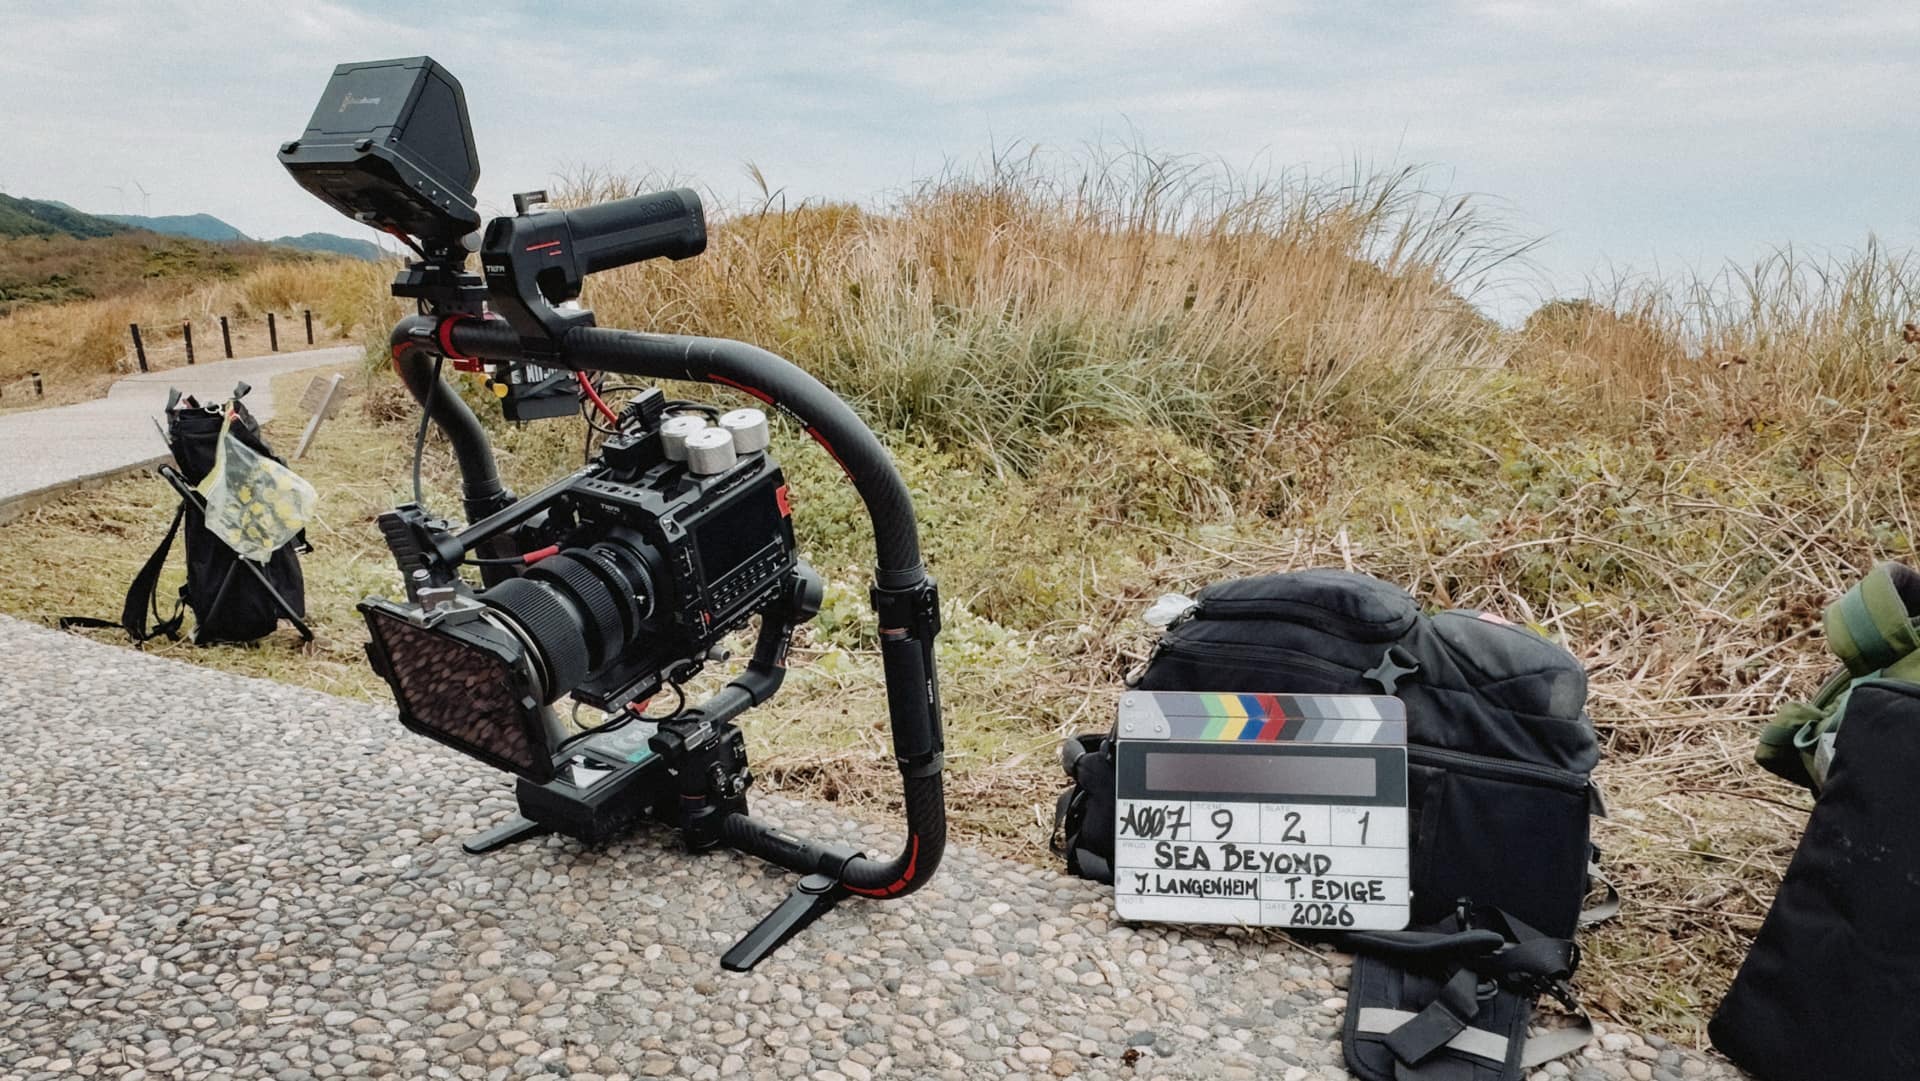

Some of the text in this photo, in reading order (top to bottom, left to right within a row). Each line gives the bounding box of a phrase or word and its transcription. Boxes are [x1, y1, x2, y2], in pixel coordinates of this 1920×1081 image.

[1211, 809, 1233, 840] 9
[1281, 812, 1306, 844] 2
[1358, 811, 1370, 845] 1
[1154, 841, 1332, 877] SEA BEYOND
[1284, 876, 1386, 903] T. EDIGE
[1290, 903, 1355, 927] 2026
